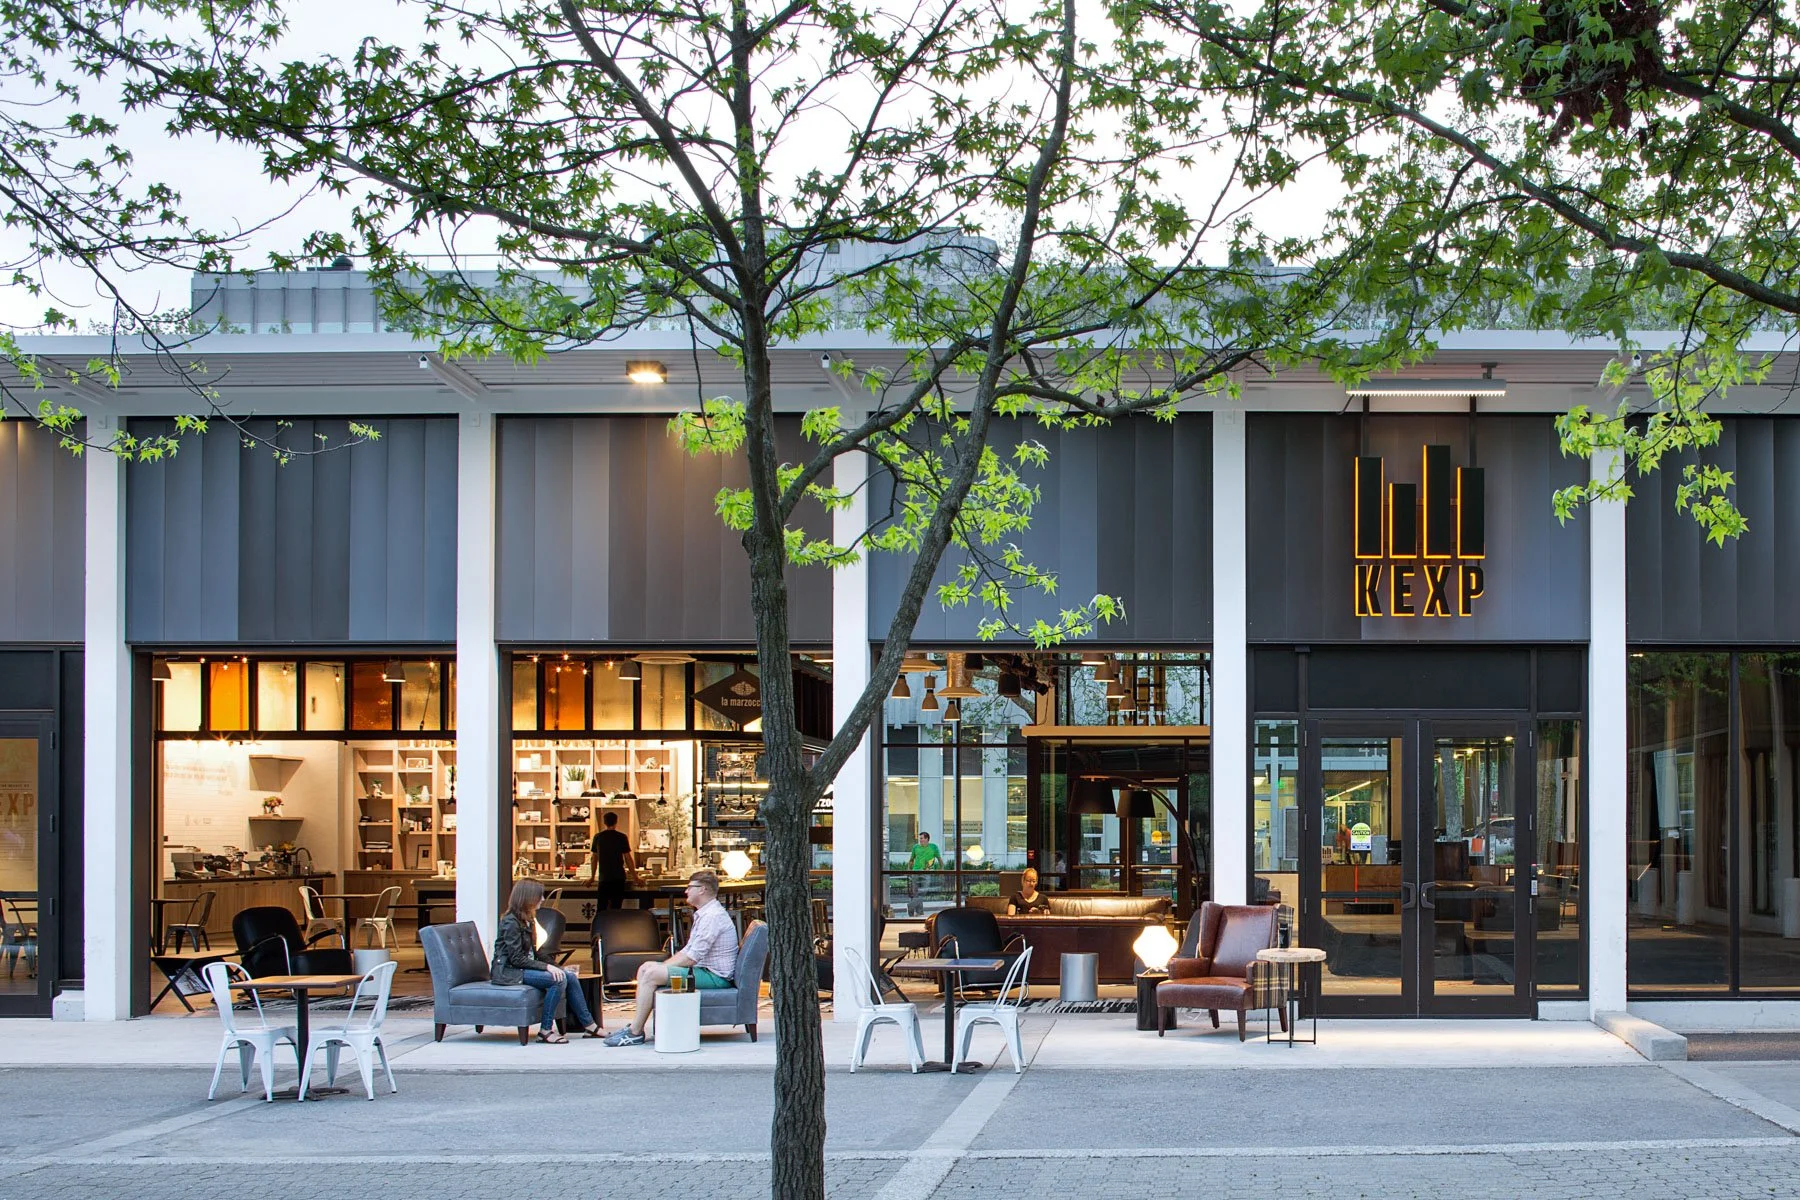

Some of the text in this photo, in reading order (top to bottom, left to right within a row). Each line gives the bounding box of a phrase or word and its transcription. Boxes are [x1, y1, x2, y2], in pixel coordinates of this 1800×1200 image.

[1355, 565, 1484, 617] KEXP
[721, 697, 762, 707] la marzocc
